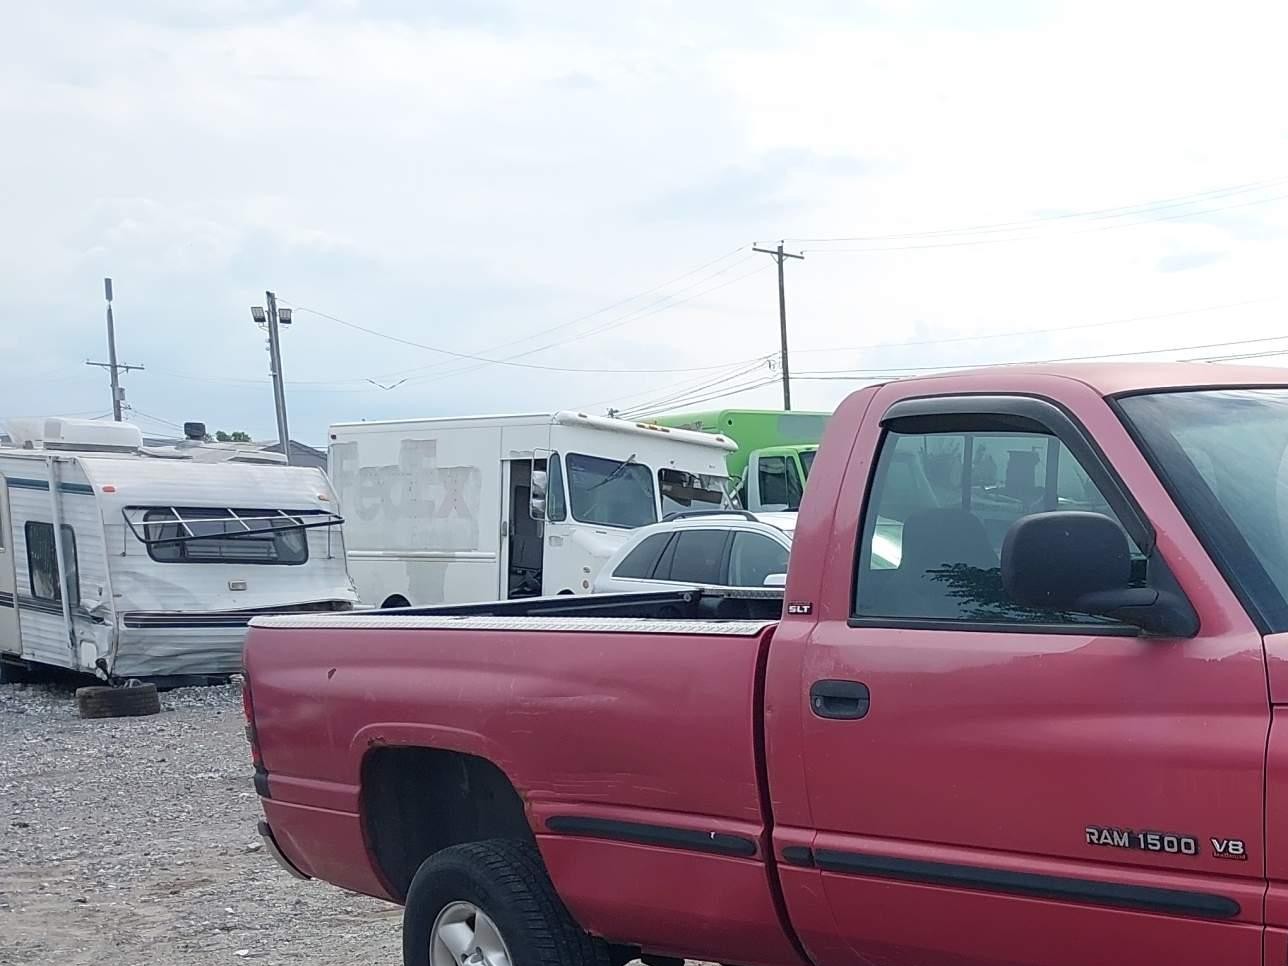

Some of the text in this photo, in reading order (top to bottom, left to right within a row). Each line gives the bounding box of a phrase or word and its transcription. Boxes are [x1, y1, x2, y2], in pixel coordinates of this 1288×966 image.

[788, 605, 811, 614] SLT
[1085, 827, 1244, 855] RAM 1500 V8
